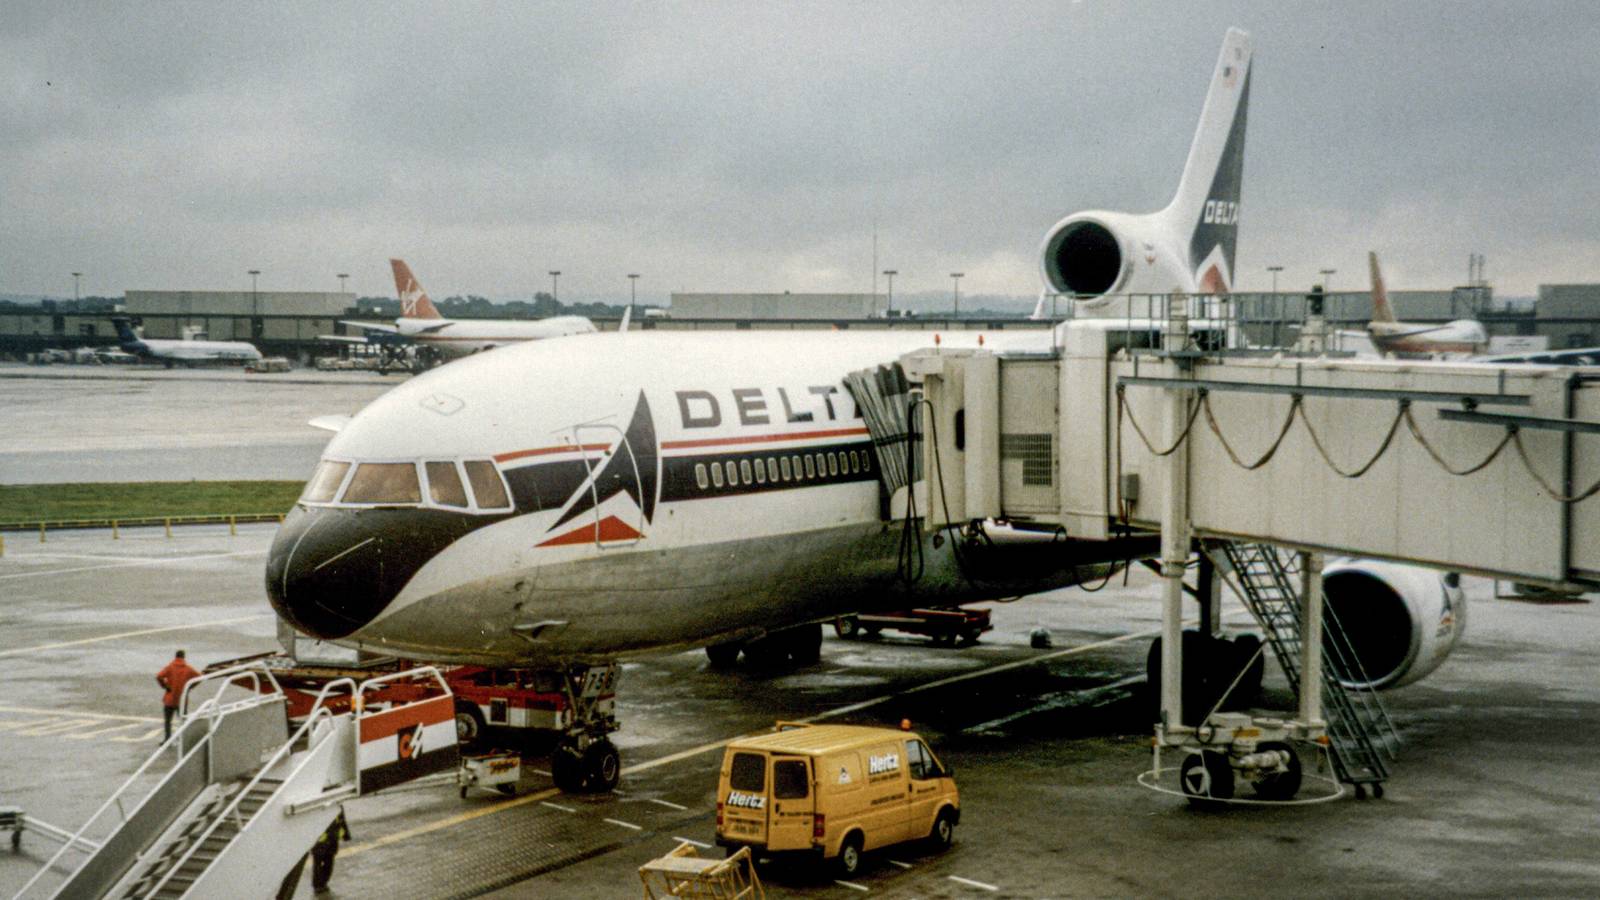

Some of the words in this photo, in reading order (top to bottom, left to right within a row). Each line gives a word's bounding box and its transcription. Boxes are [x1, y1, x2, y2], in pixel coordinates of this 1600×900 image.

[675, 386, 864, 429] DELT
[868, 753, 900, 775] Hertz
[726, 790, 767, 810] Hertz
